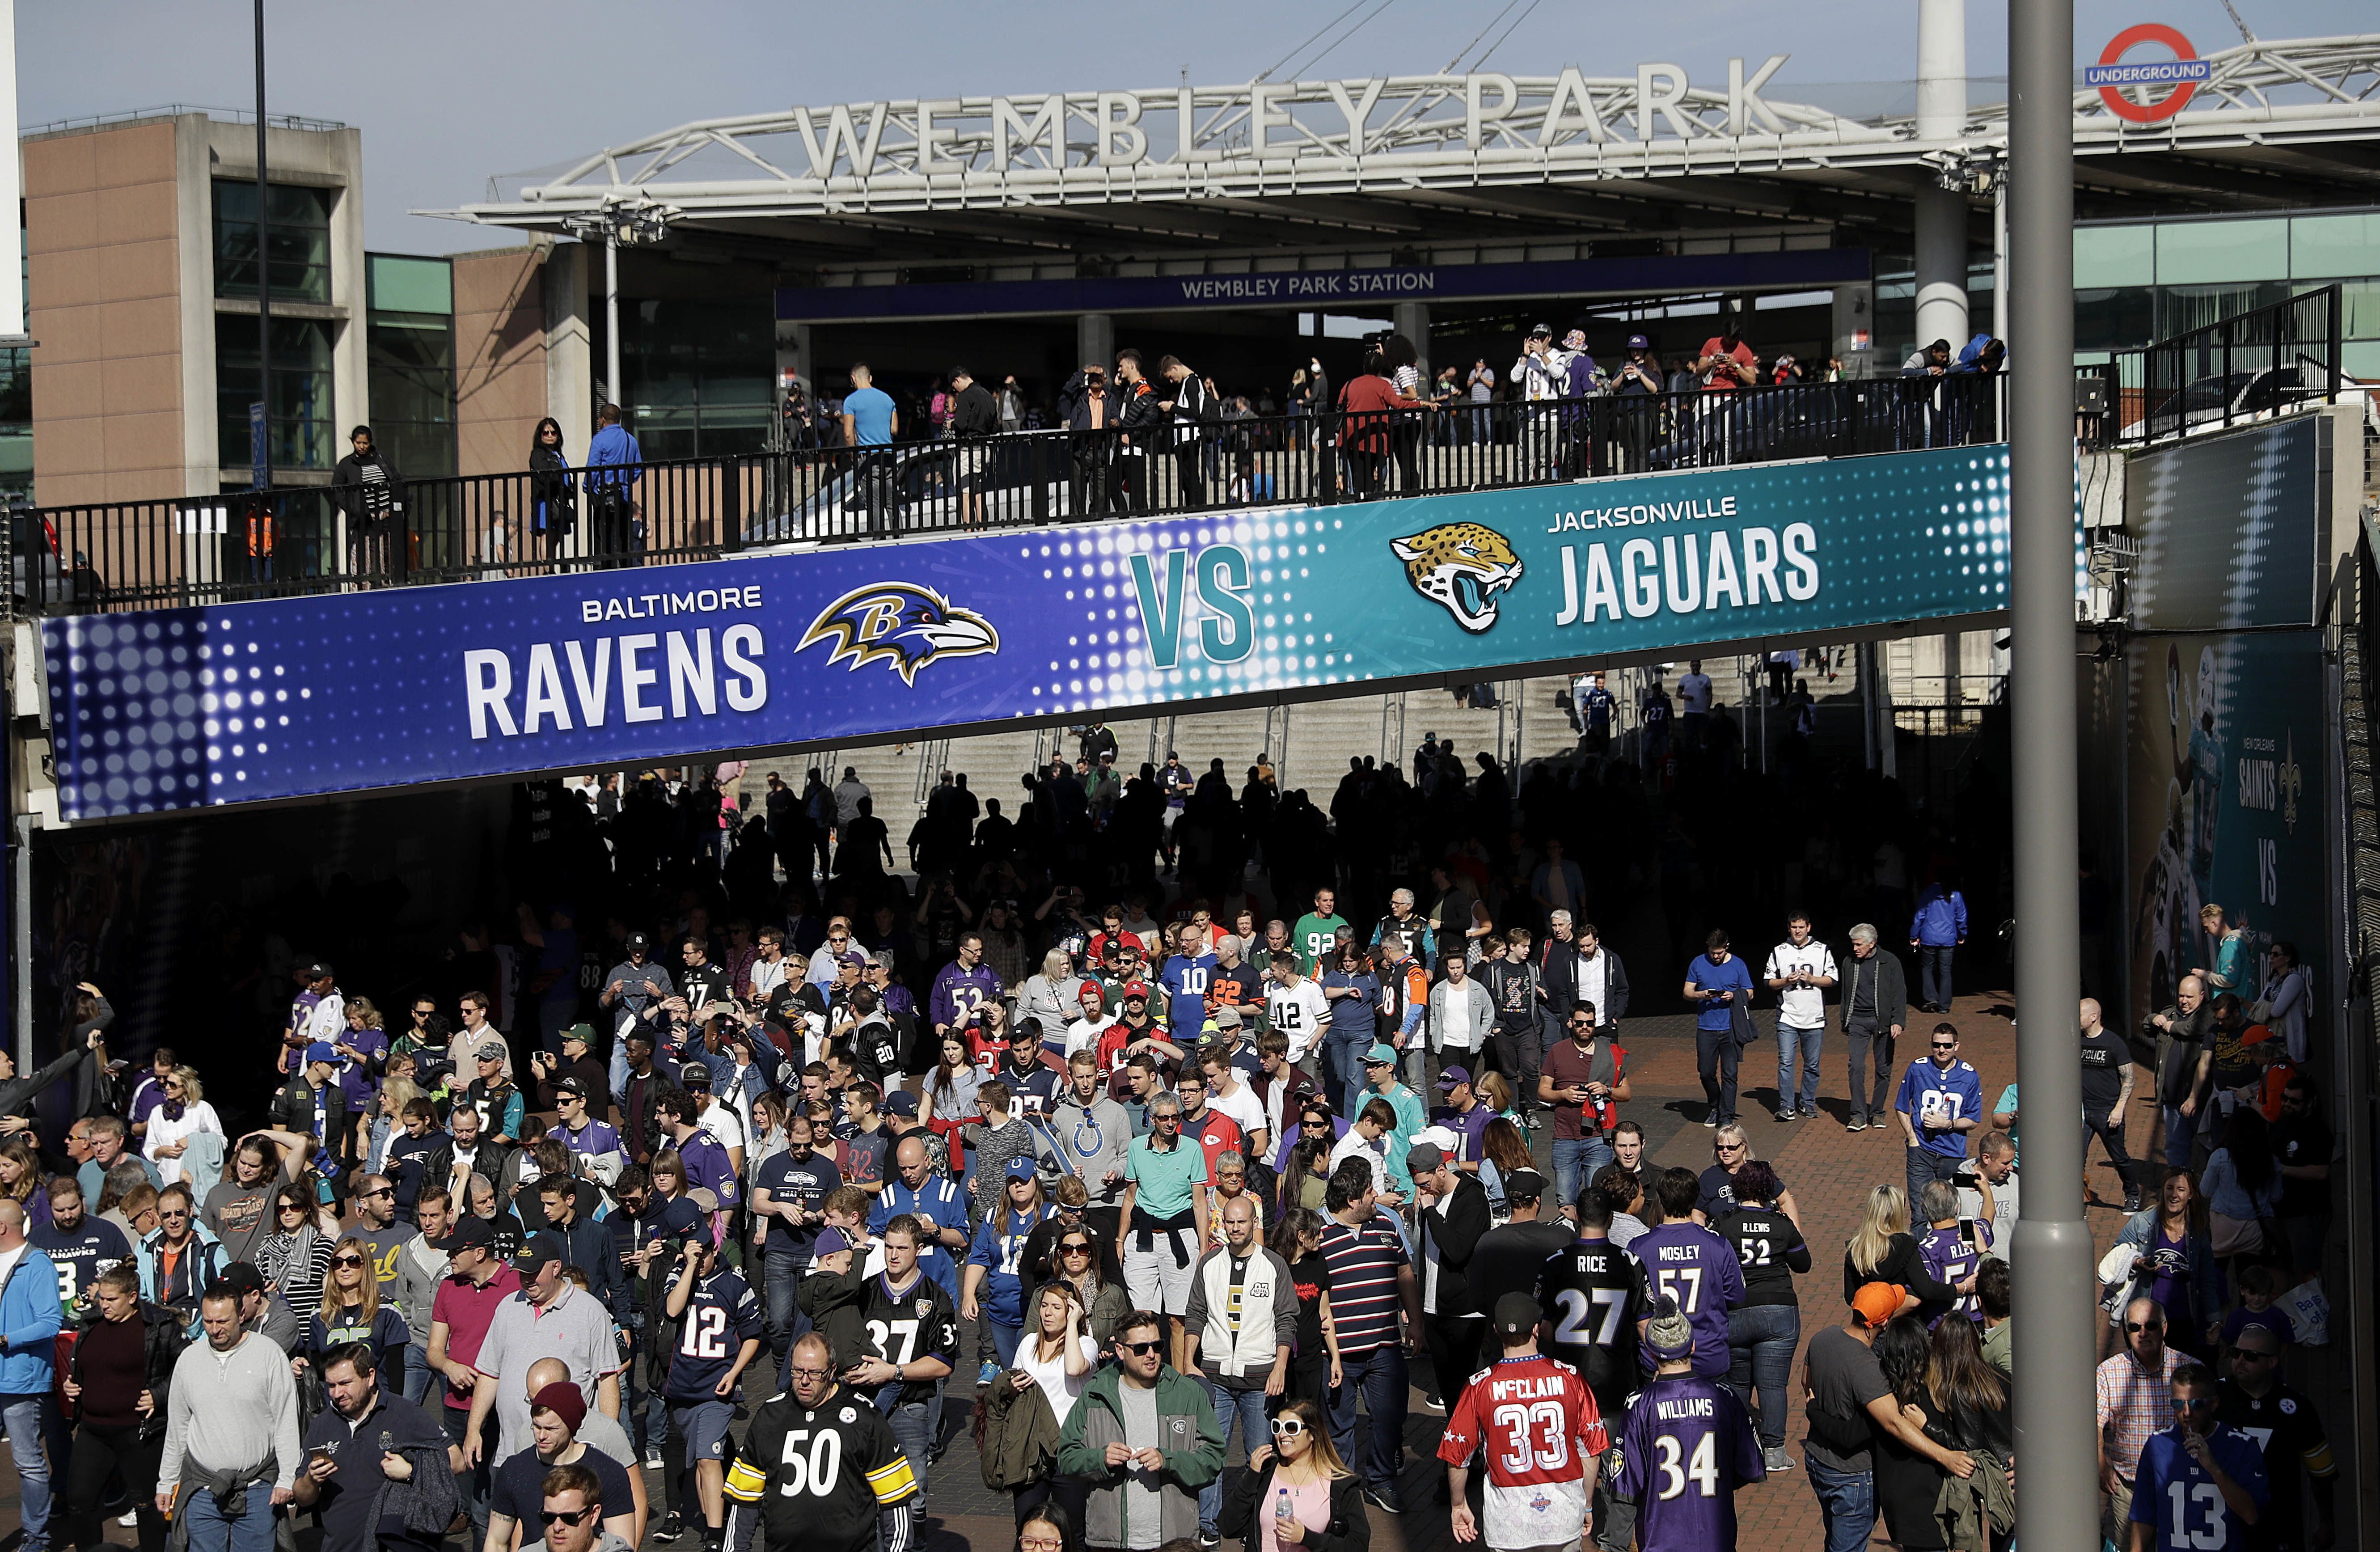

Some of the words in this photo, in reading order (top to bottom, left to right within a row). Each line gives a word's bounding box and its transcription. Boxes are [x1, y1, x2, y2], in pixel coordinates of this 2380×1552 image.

[2089, 64, 2206, 83] UNDERGROUND
[792, 78, 1388, 179] WEMBLEY
[1466, 54, 1791, 150] PARK
[1181, 278, 1281, 299] WEMBLEY
[1288, 275, 1341, 295] PARK
[1349, 271, 1434, 292] STATION
[1557, 371, 1571, 395] 2
[1547, 496, 1737, 533] JACKSONVILLE
[1556, 522, 1818, 626] JAGUARS
[582, 585, 762, 624] BALTIMORE
[1128, 544, 1256, 670] VS
[464, 623, 769, 740] RAVENS
[1650, 707, 1665, 721] 27
[2243, 738, 2253, 750] NEW
[2253, 738, 2275, 752] ORLEANS
[2239, 757, 2275, 812] SAINTS
[2258, 837, 2277, 907] VS
[1306, 932, 1336, 957] 92
[581, 964, 601, 989] 88
[1181, 967, 1208, 995] 10
[1213, 979, 1242, 1005] 22
[292, 1003, 314, 1036] 52
[950, 987, 985, 1021] 52
[1277, 1002, 1302, 1029] 12
[875, 1045, 895, 1064] 20
[2081, 1049, 2107, 1062] POLICE
[475, 1100, 492, 1133] 5
[849, 1149, 875, 1180] 32
[1742, 1222, 1771, 1233] R.LEWIS
[48, 1249, 97, 1259] AHAWKS
[1577, 1255, 1607, 1273] RICE
[1658, 1245, 1700, 1261] MOSLEY
[1741, 1238, 1772, 1266] 52
[54, 1261, 78, 1301] 3
[694, 1292, 714, 1300] PATRIOTS
[1657, 1268, 1702, 1314] 57
[681, 1303, 727, 1358] 12
[1555, 1287, 1629, 1346] 27
[866, 1319, 919, 1365] 37
[1657, 1398, 1714, 1421] WILLIAMS
[1493, 1400, 1570, 1474] 33
[780, 1428, 842, 1497] 50
[1654, 1431, 1719, 1501] 34
[2167, 1480, 2227, 1550] 13
